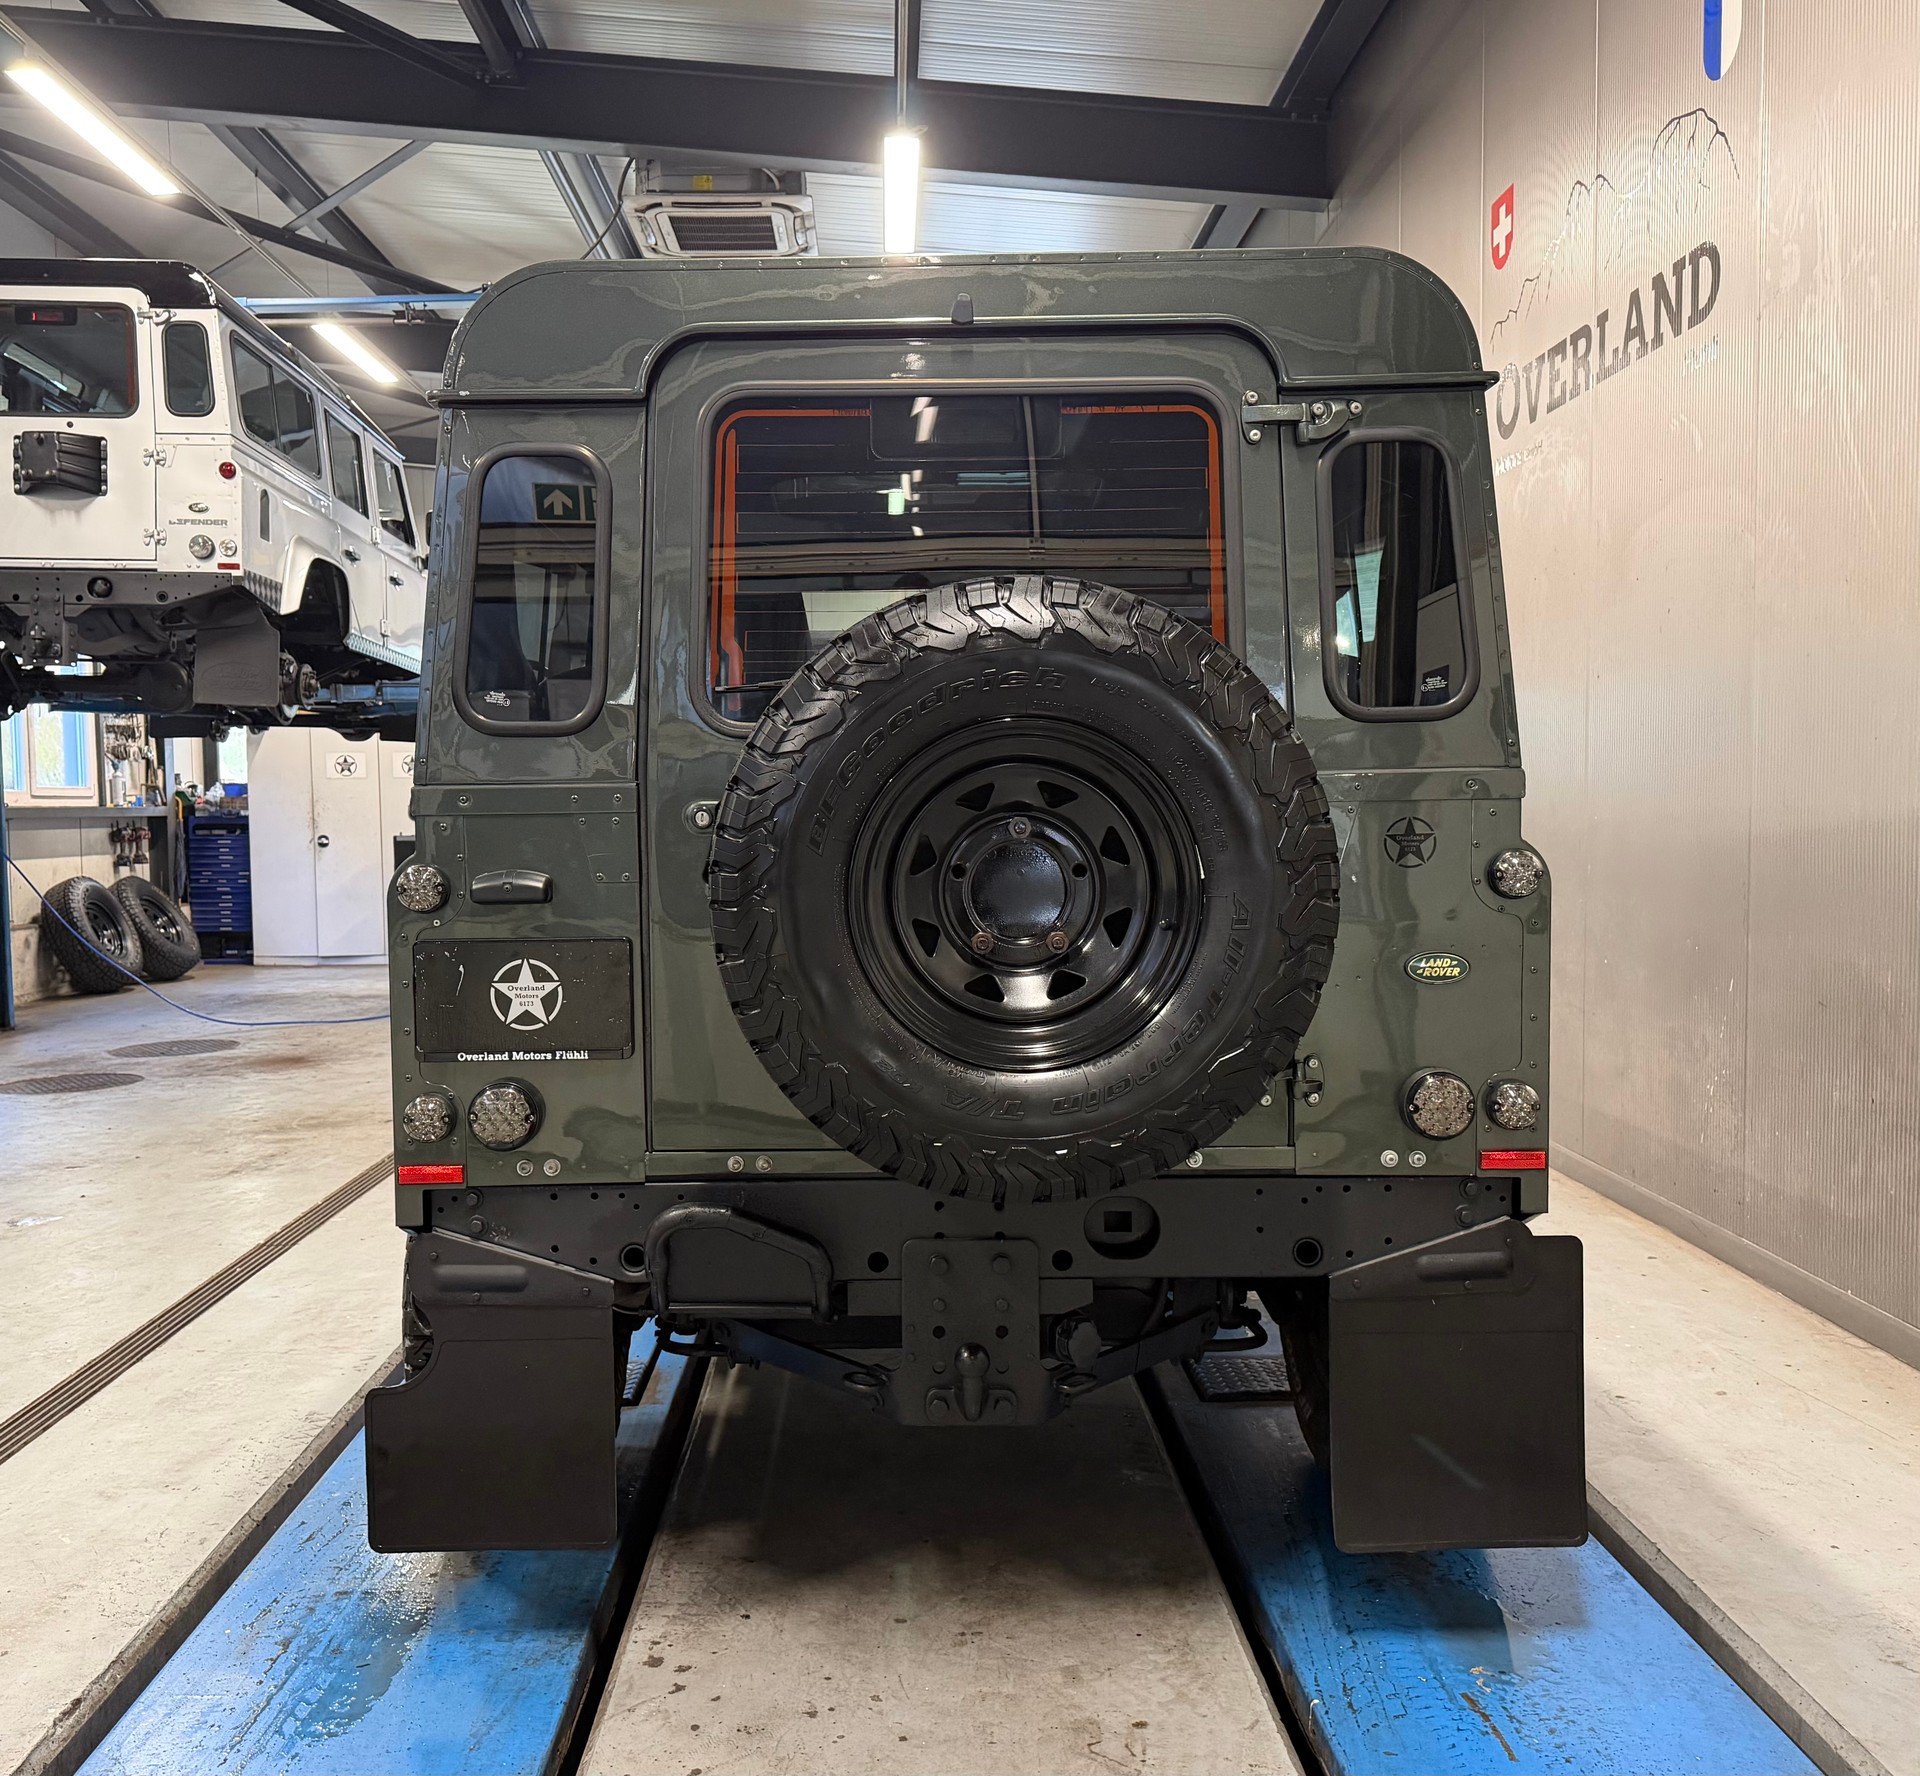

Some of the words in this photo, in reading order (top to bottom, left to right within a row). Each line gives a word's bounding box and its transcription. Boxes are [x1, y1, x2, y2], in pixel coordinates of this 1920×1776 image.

[1496, 240, 1721, 440] OVERLAND
[808, 666, 1068, 856] BFGoodrich
[1420, 958, 1451, 968] LAND
[1423, 967, 1461, 977] ROVER
[507, 984, 546, 992] Overland
[1051, 891, 1250, 1116] All-Terrain
[457, 1052, 510, 1062] Overland
[511, 1051, 552, 1061] Motors
[555, 1050, 589, 1060] Flühli
